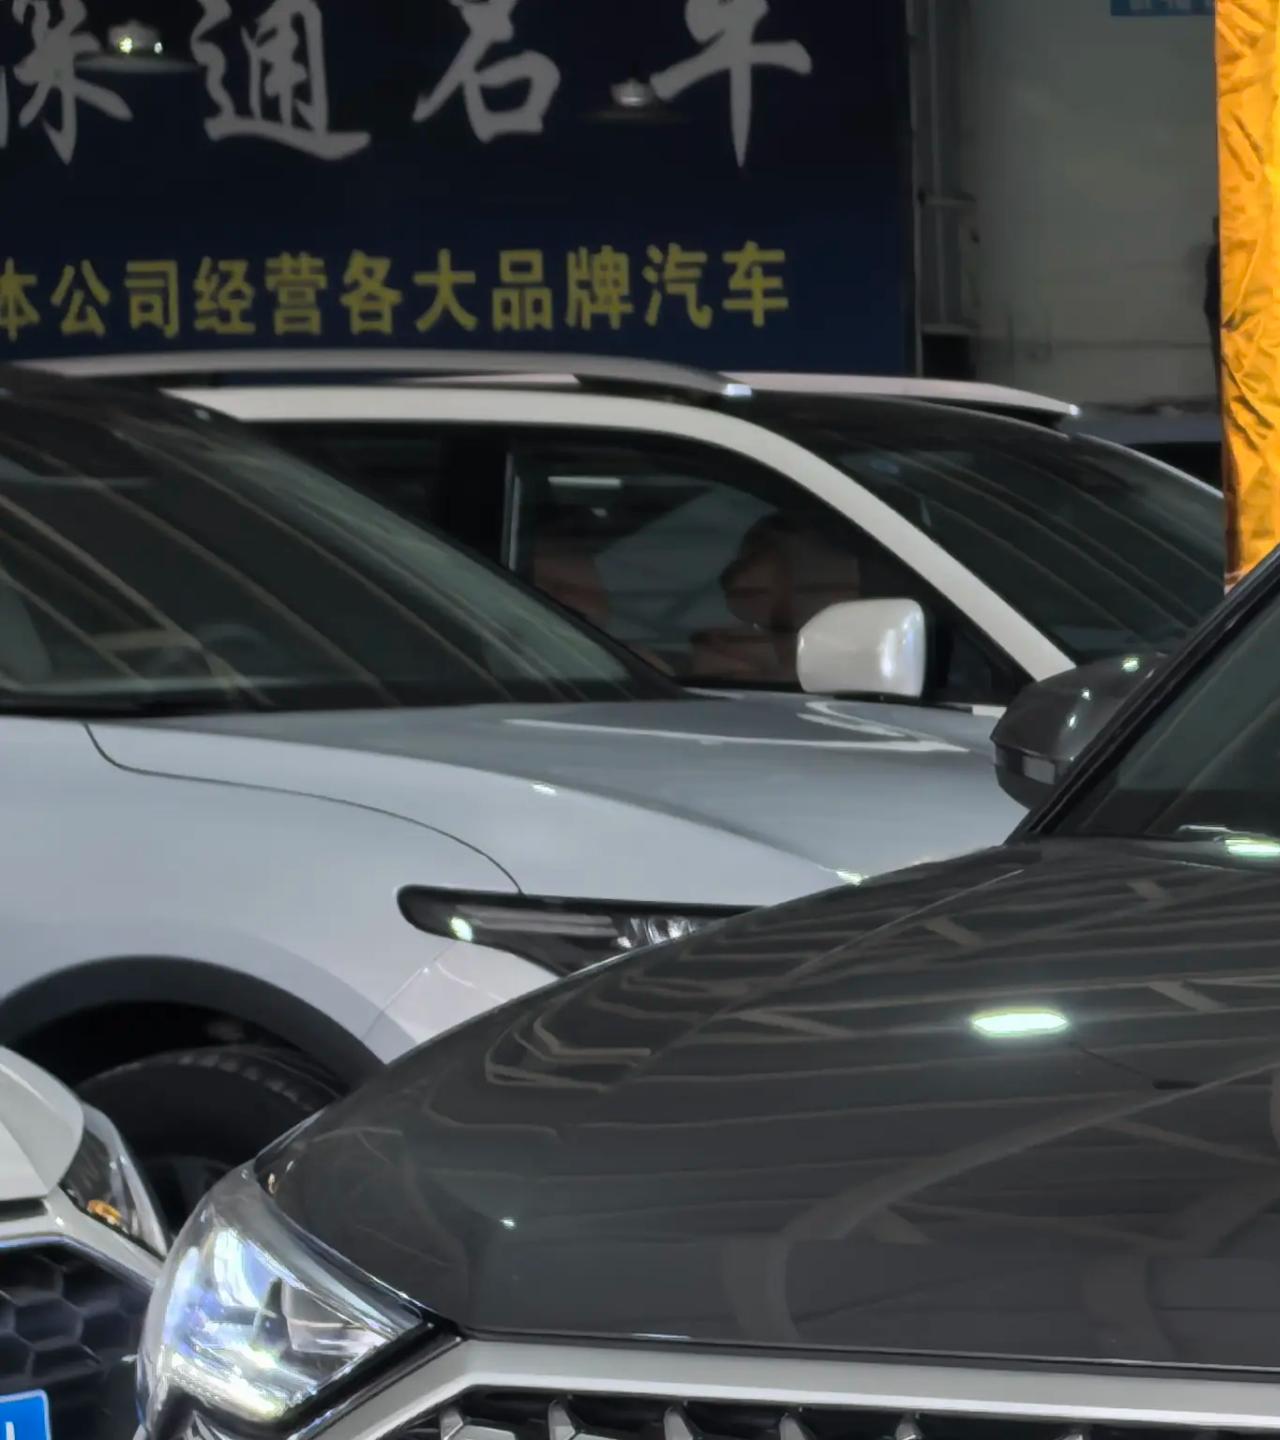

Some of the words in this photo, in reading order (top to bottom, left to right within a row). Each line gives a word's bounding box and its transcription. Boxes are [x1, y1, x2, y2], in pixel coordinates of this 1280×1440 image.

[0, 240, 791, 342] 本公司经营各大品牌汽车
